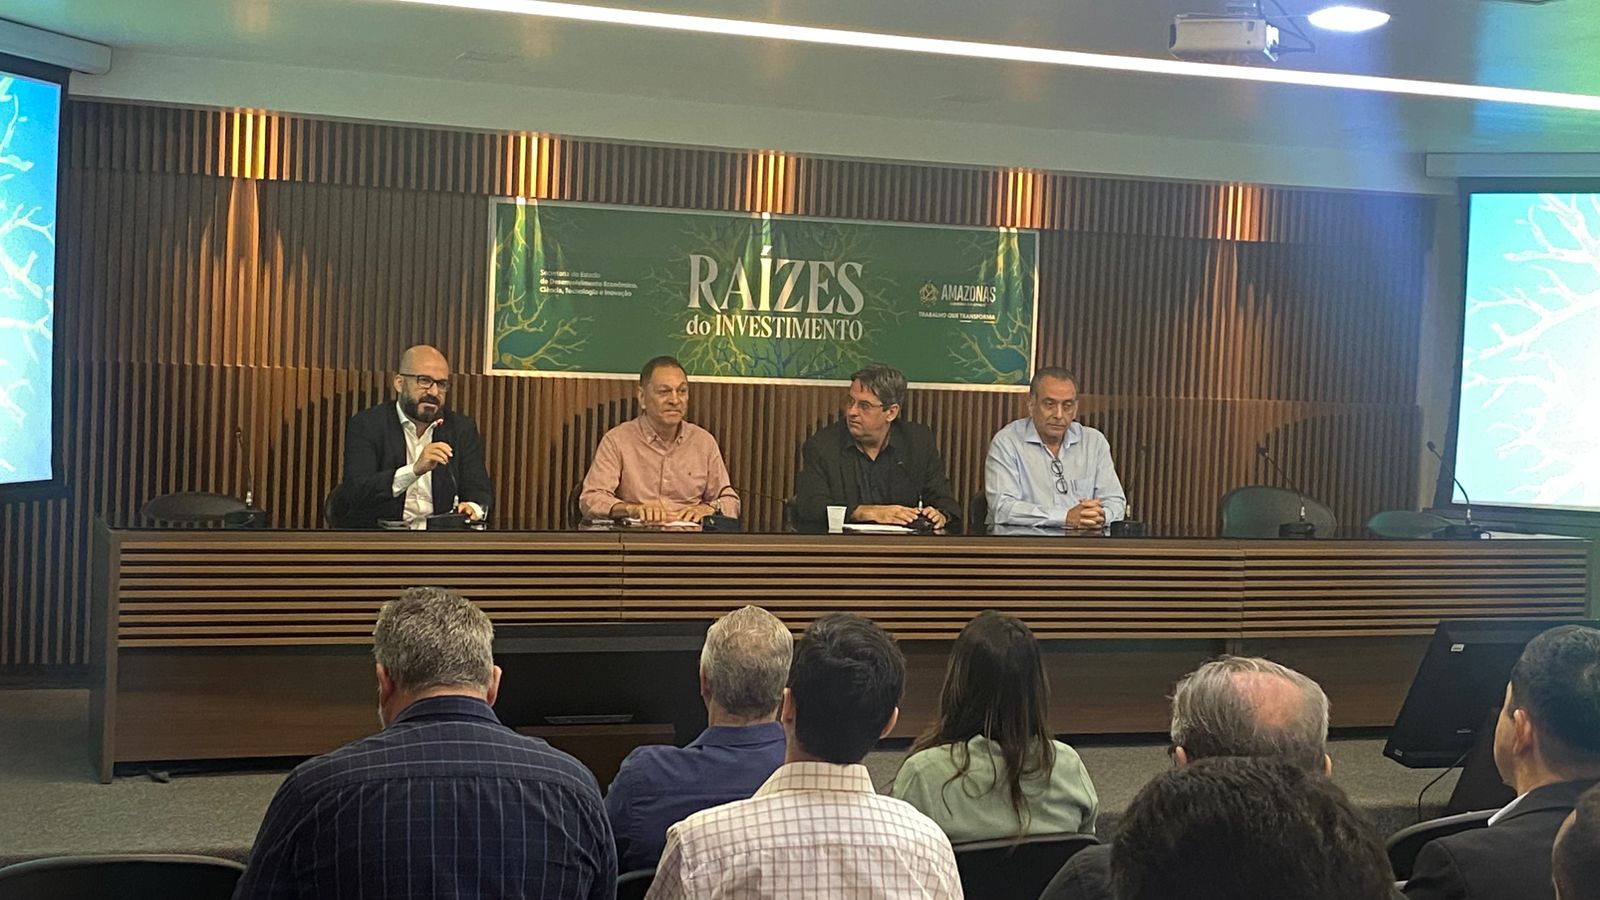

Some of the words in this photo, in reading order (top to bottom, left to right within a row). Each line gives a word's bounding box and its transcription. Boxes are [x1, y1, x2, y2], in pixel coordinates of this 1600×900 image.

[580, 271, 601, 279] Estado
[687, 245, 865, 316] RAÍZES
[565, 287, 598, 297] Tecnologia
[604, 289, 632, 298] Inovação
[941, 284, 996, 303] AMAZONAS
[919, 311, 946, 319] TRABALHO
[960, 312, 996, 320] TRANSFORMA
[686, 314, 711, 336] do
[715, 314, 863, 341] INVESTIMENTO
